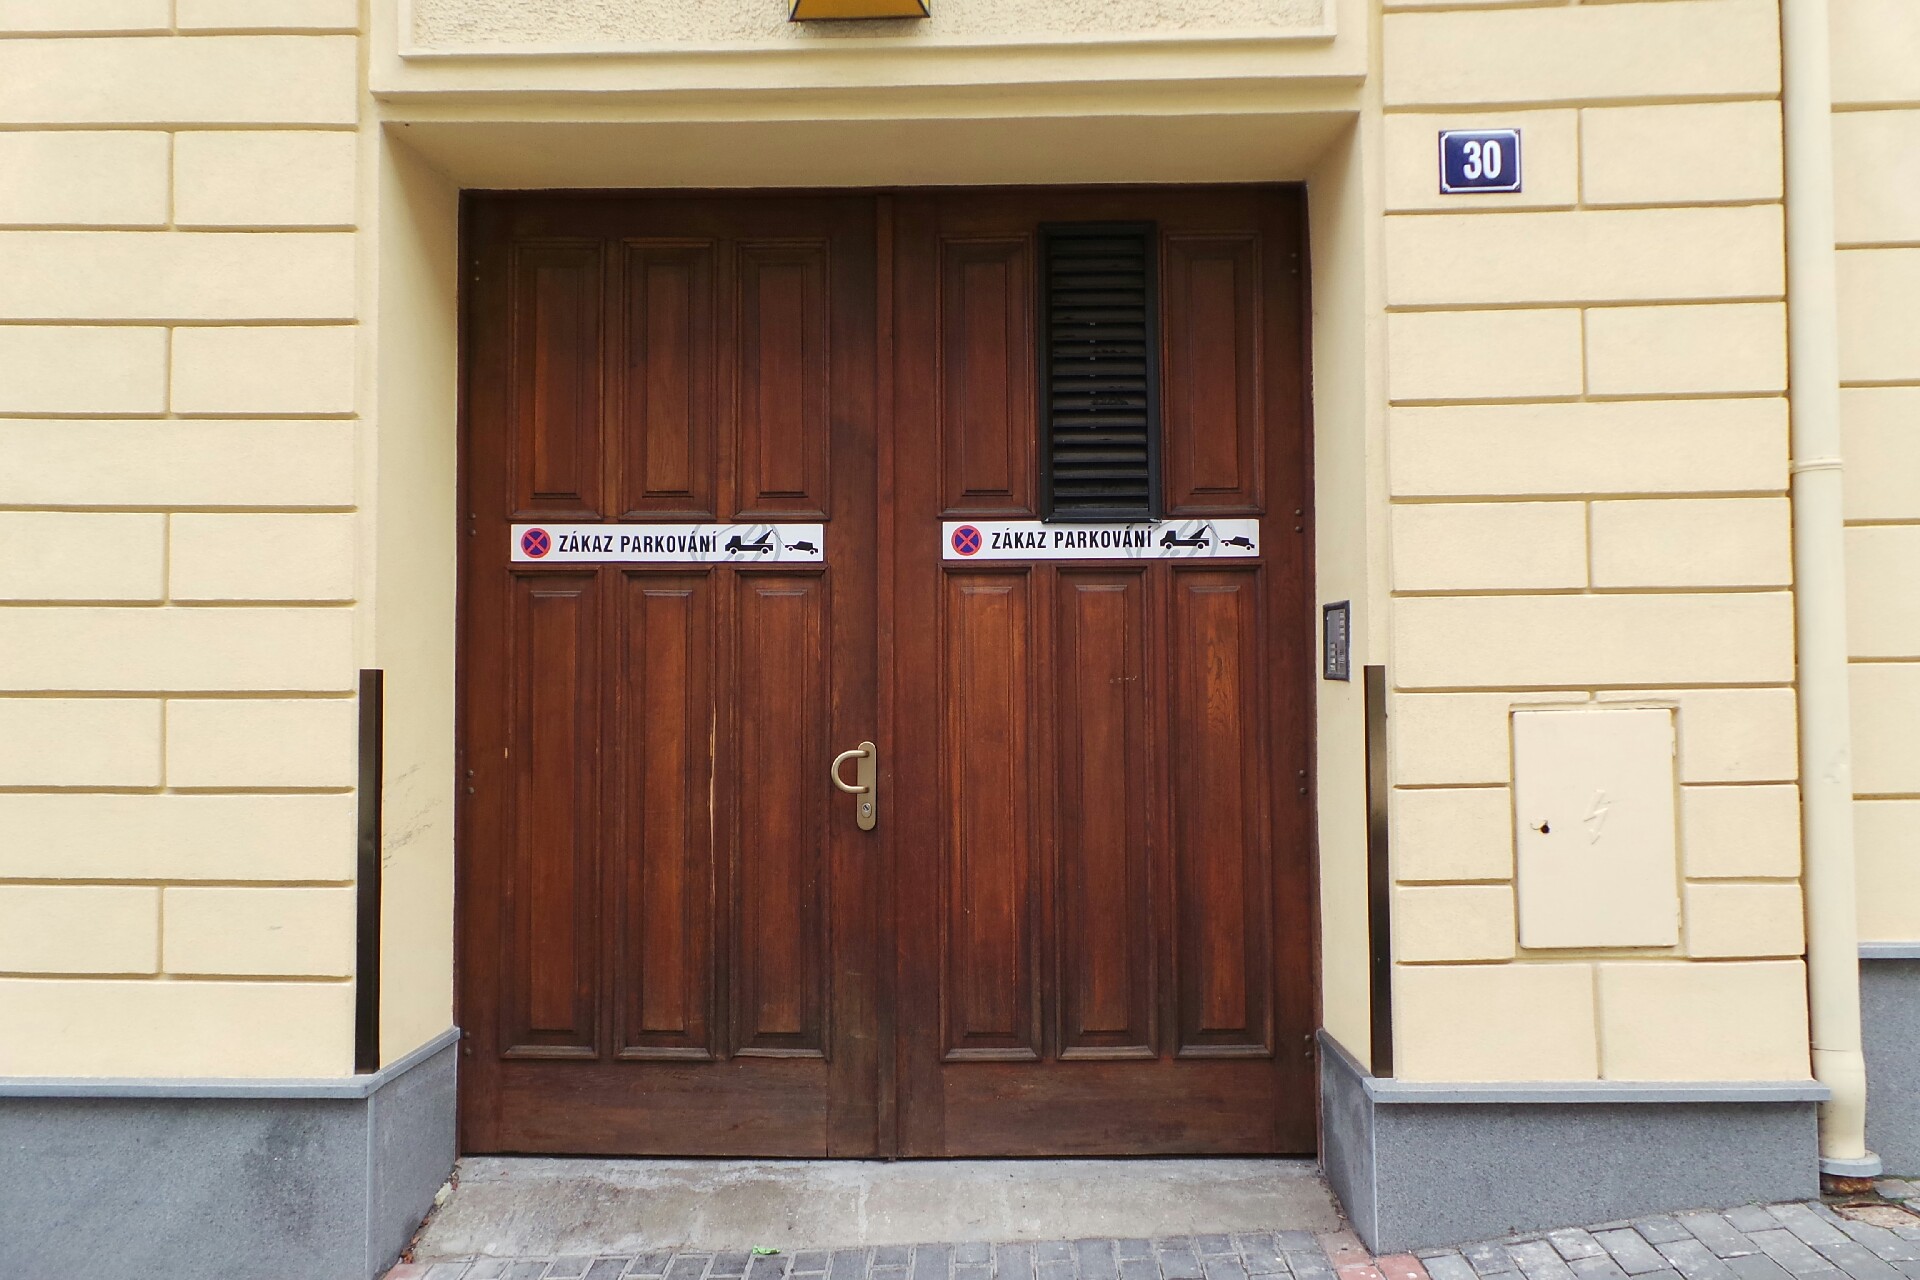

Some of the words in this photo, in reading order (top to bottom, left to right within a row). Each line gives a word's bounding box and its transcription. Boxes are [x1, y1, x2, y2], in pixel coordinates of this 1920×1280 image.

[1463, 140, 1502, 180] 30
[558, 530, 614, 553] ZÁKAZ
[620, 530, 718, 553] PARKOVÁNÍ
[991, 527, 1047, 550] ZÁKAZ
[1054, 526, 1152, 549] PARKOVÁNÍ
